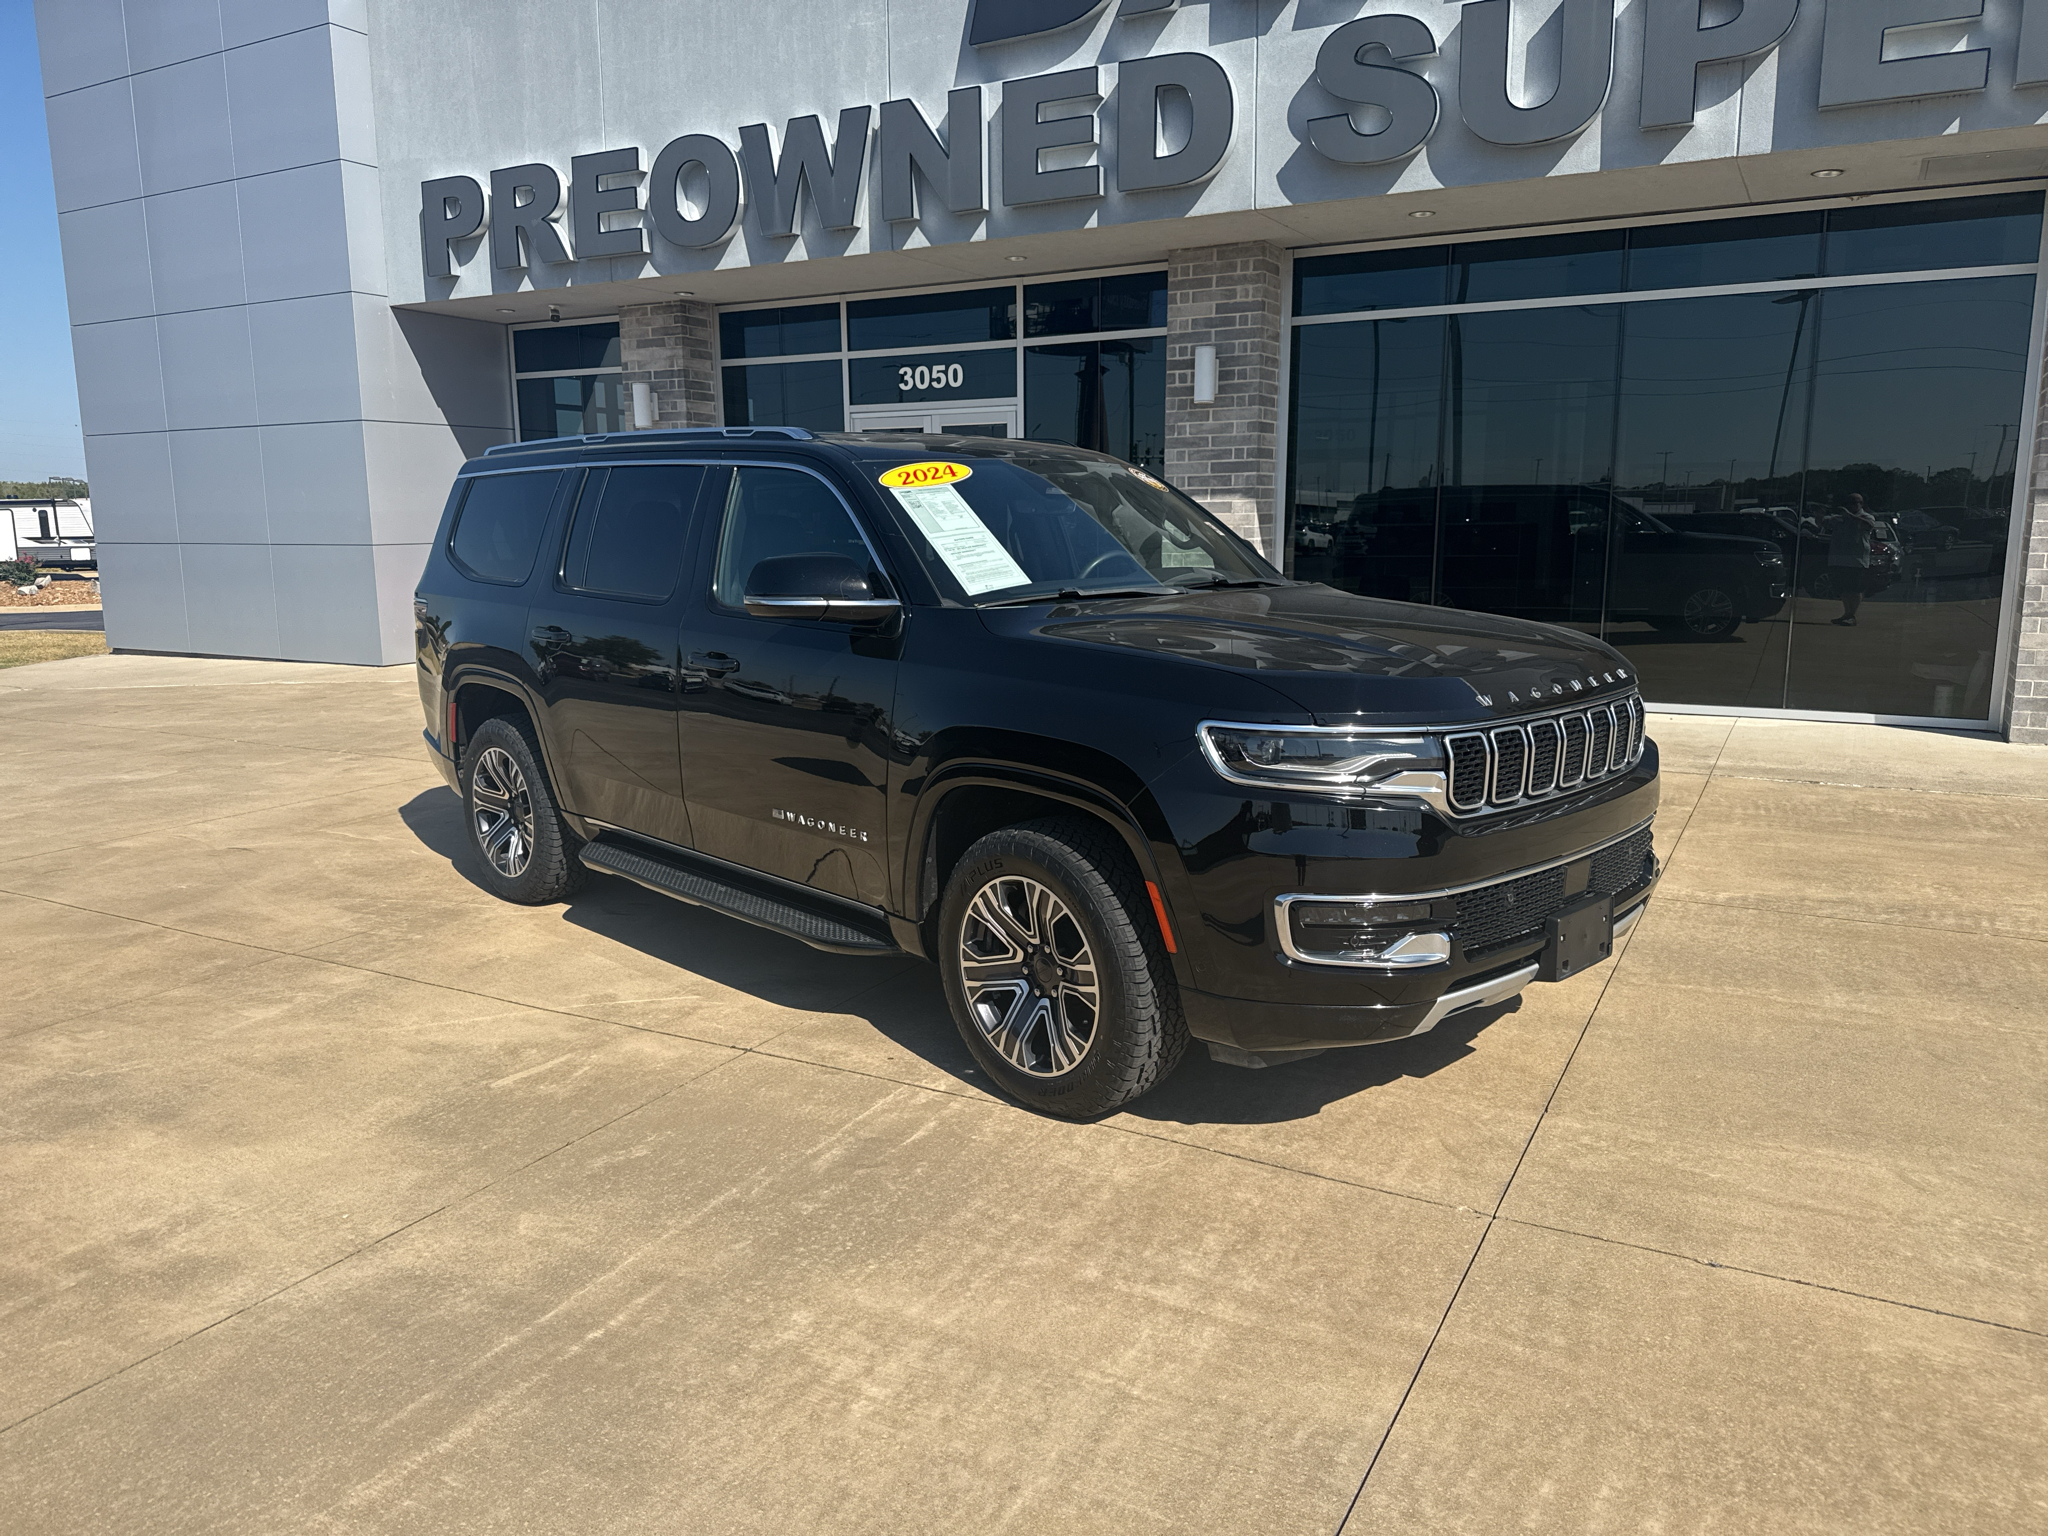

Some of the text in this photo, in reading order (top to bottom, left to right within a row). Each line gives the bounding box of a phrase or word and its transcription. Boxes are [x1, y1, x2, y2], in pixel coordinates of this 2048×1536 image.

[420, 0, 2048, 277] PREOWNED SUPE
[898, 363, 964, 391] 3050
[897, 464, 958, 486] 2024
[1475, 668, 1629, 707] WAGONEER
[786, 811, 868, 842] WAGONEER
